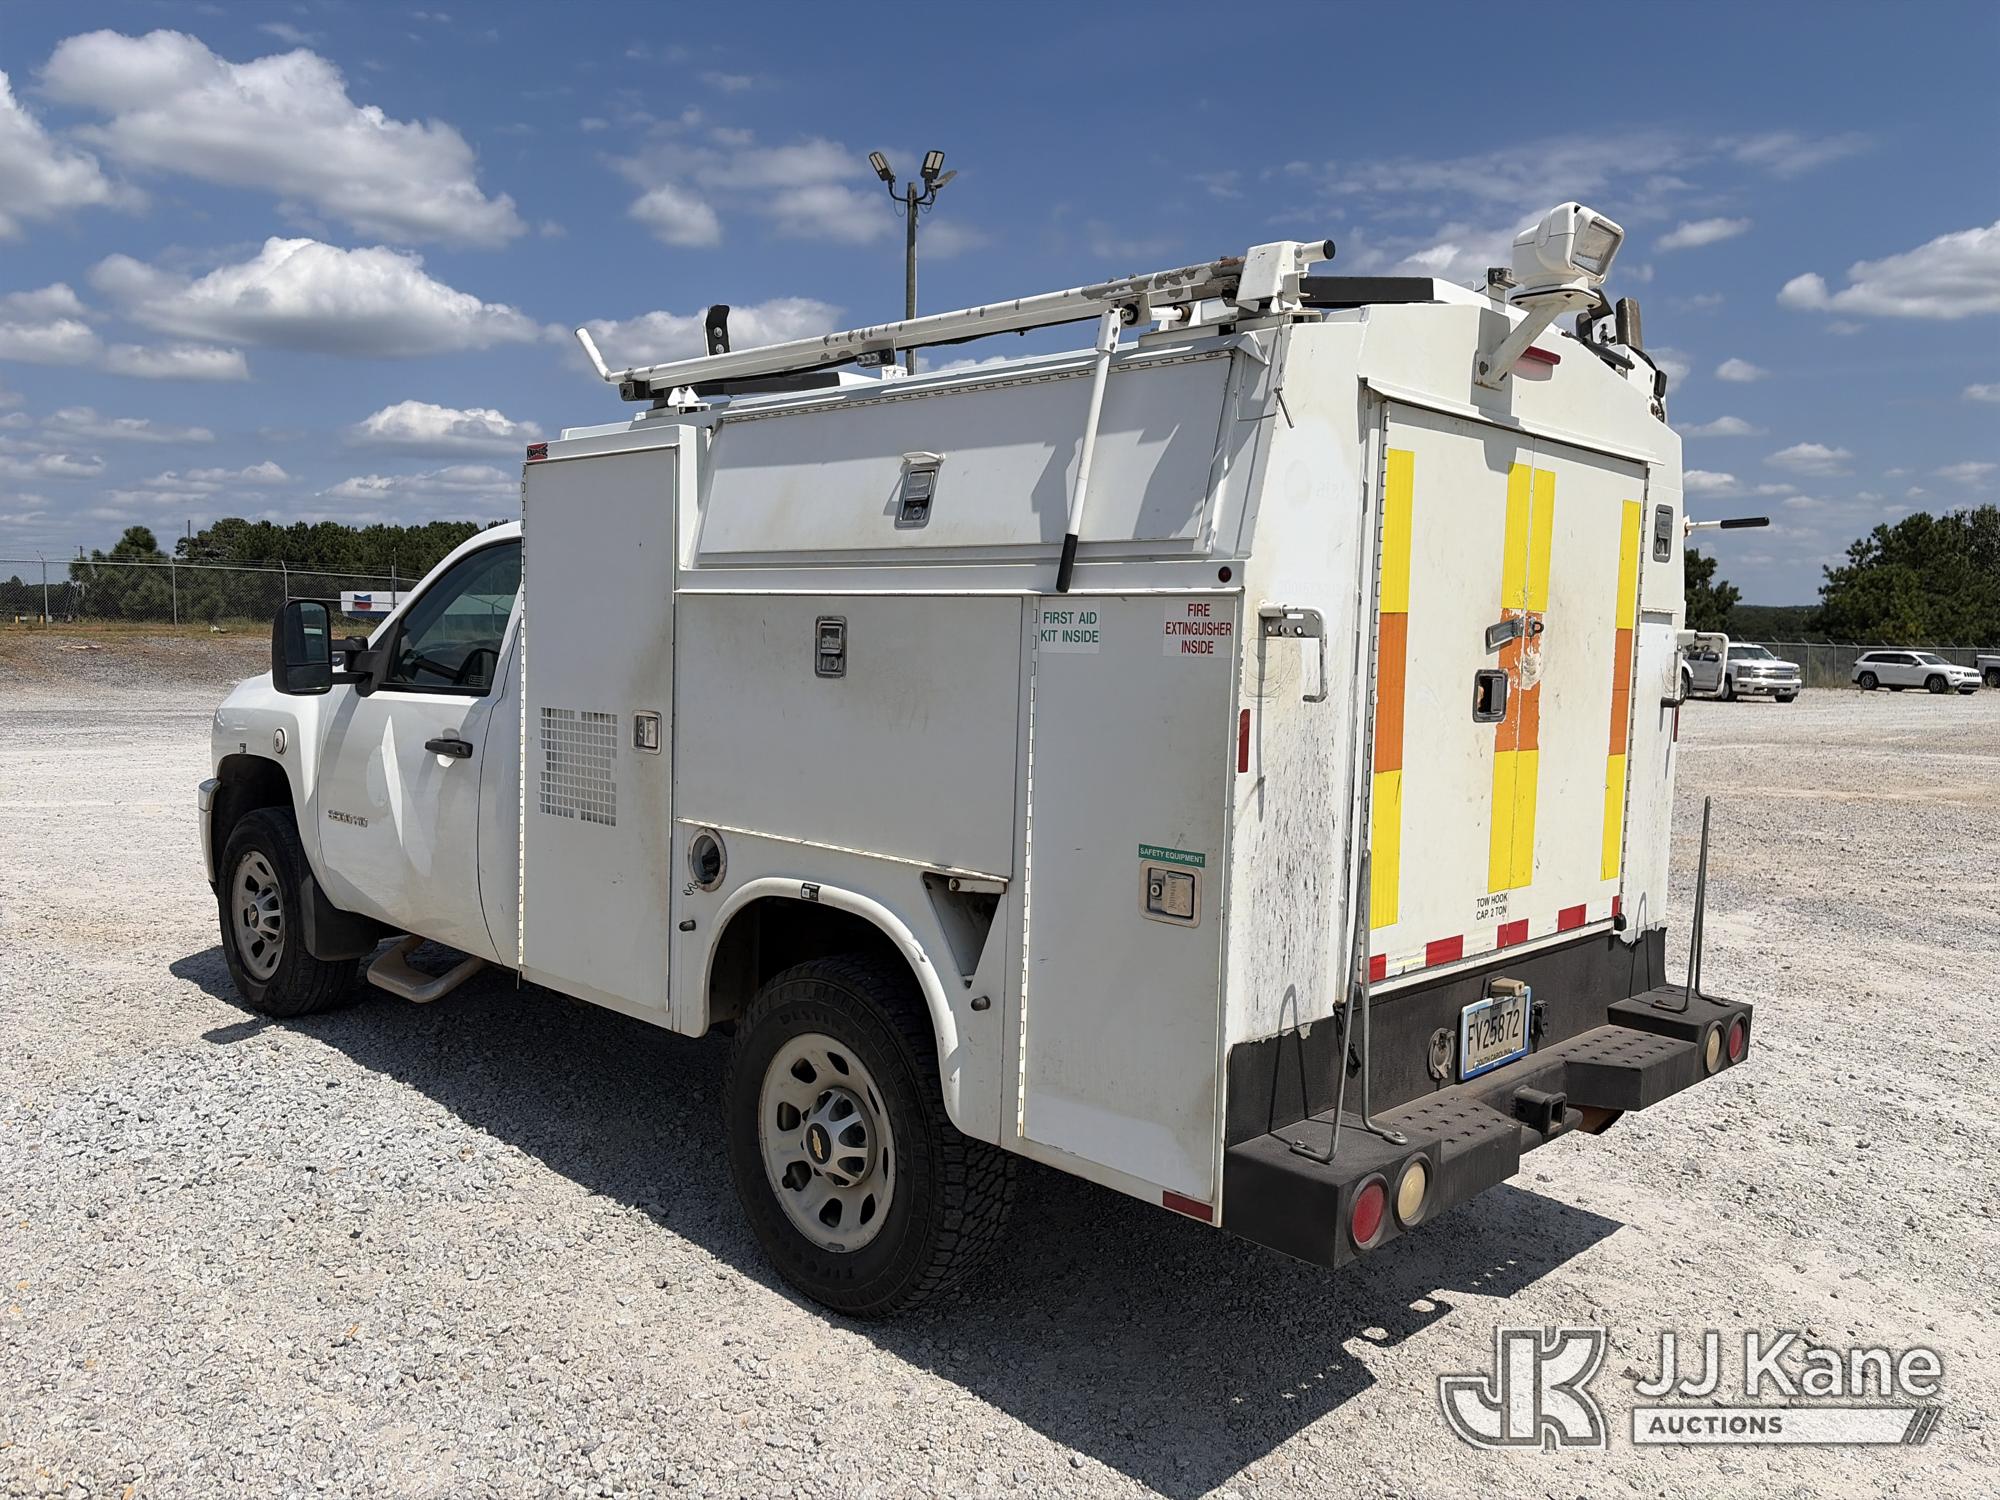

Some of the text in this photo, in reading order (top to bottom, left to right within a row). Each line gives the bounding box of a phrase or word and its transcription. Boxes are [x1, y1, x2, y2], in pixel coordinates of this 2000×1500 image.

[1187, 603, 1211, 617] FIRE
[1043, 611, 1098, 625] FIRST AID
[1165, 621, 1232, 636] EXTINGUISHER
[1040, 629, 1099, 643] KIT INSIDE
[1181, 640, 1214, 654] INSIDE
[1140, 847, 1204, 863] SAFETY EQUIPMENT
[1476, 892, 1508, 908] TOW HOOK
[1490, 908, 1495, 917] 2
[1495, 905, 1507, 916] TON
[1467, 1009, 1520, 1056] FV25872
